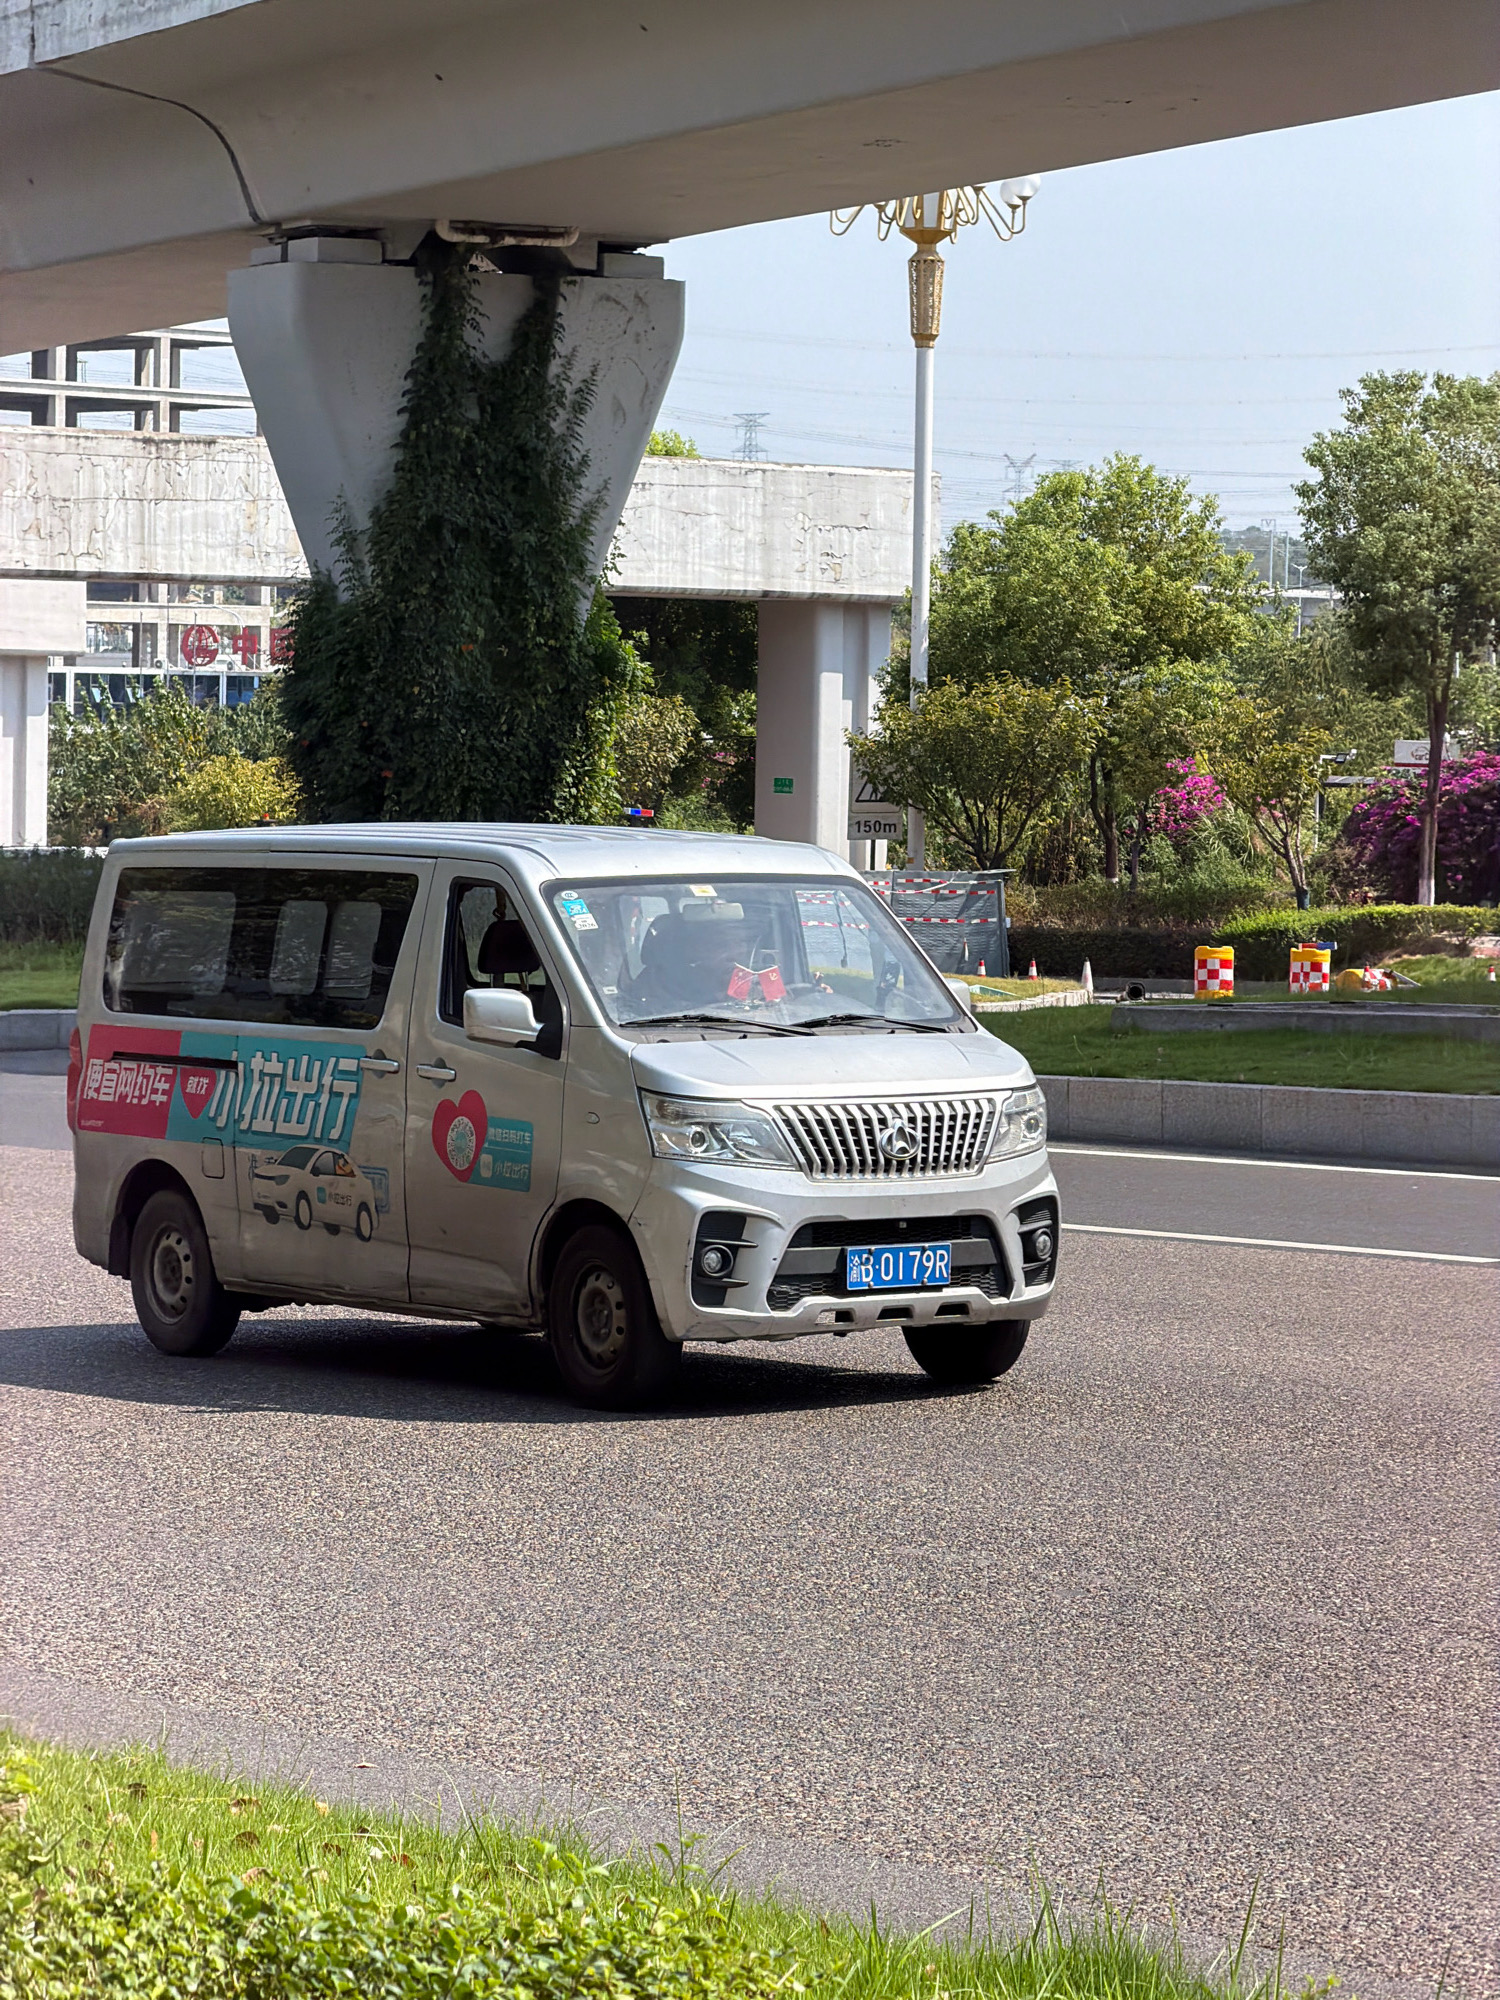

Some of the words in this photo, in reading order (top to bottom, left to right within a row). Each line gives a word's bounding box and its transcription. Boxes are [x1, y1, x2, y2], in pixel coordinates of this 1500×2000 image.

[855, 820, 897, 833] 150m
[83, 1058, 173, 1106] 便宜网约车
[185, 1075, 209, 1095] 就找
[208, 1051, 359, 1140] 小拉出行
